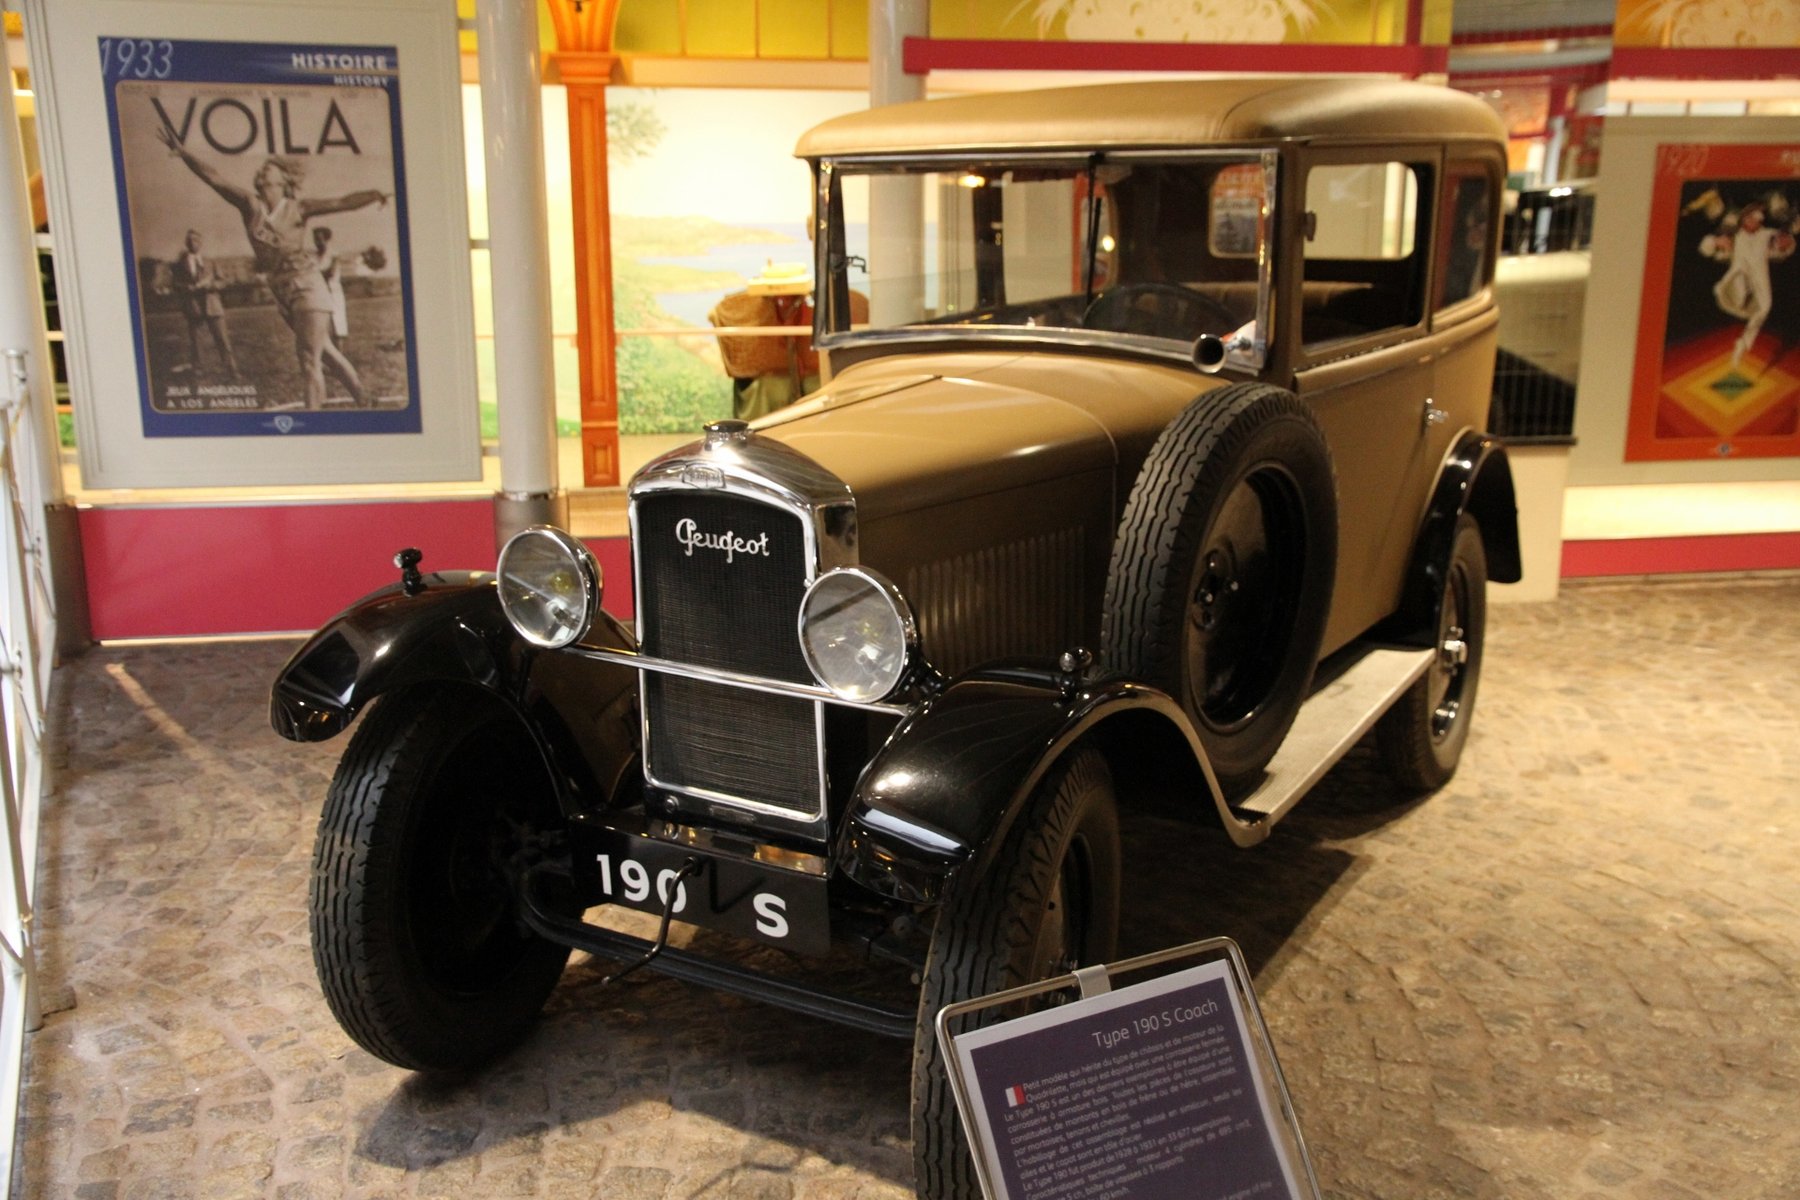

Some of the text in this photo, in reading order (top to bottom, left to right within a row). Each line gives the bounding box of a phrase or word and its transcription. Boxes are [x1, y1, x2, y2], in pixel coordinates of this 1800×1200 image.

[100, 38, 174, 80] 1933
[291, 53, 388, 70] HISTOIRE
[333, 73, 390, 88] HISTORY
[150, 96, 361, 156] VOILA
[181, 398, 204, 409] LOS
[209, 397, 259, 408] ANGELES
[675, 518, 770, 564] Peugeot
[596, 854, 789, 938] 190 S
[1092, 1000, 1217, 1048] Type 190 S Coach
[1023, 1081, 1040, 1090] Petit
[1042, 1073, 1068, 1084] modèle
[1082, 1063, 1101, 1072] hérite
[1113, 1055, 1128, 1064] type
[1183, 1031, 1205, 1041] moteur
[1070, 1079, 1086, 1088] mais
[1100, 1071, 1110, 1079] est
[1135, 1059, 1149, 1068] avec
[1152, 1055, 1163, 1063] une
[1008, 1116, 1047, 1133] carrosserie
[1058, 1103, 1090, 1116] armature
[1016, 1108, 1033, 1118] Type
[1036, 1101, 1050, 1110] 190
[1059, 1096, 1070, 1104] est
[1083, 1089, 1095, 1097] des
[1011, 1127, 1051, 1144] constituées
[1065, 1112, 1099, 1125] montants
[1112, 1102, 1127, 1111] bois
[1072, 1141, 1083, 1149] cet
[1130, 1121, 1141, 1129] est
[1014, 1147, 1025, 1157] par
[1066, 1127, 1090, 1138] tenons
[1020, 1169, 1037, 1179] ailes
[1056, 1155, 1076, 1167] capot
[1077, 1150, 1093, 1160] sont
[1033, 1177, 1052, 1187] Type
[1054, 1170, 1067, 1179] 190
[1080, 1158, 1104, 1172] produit
